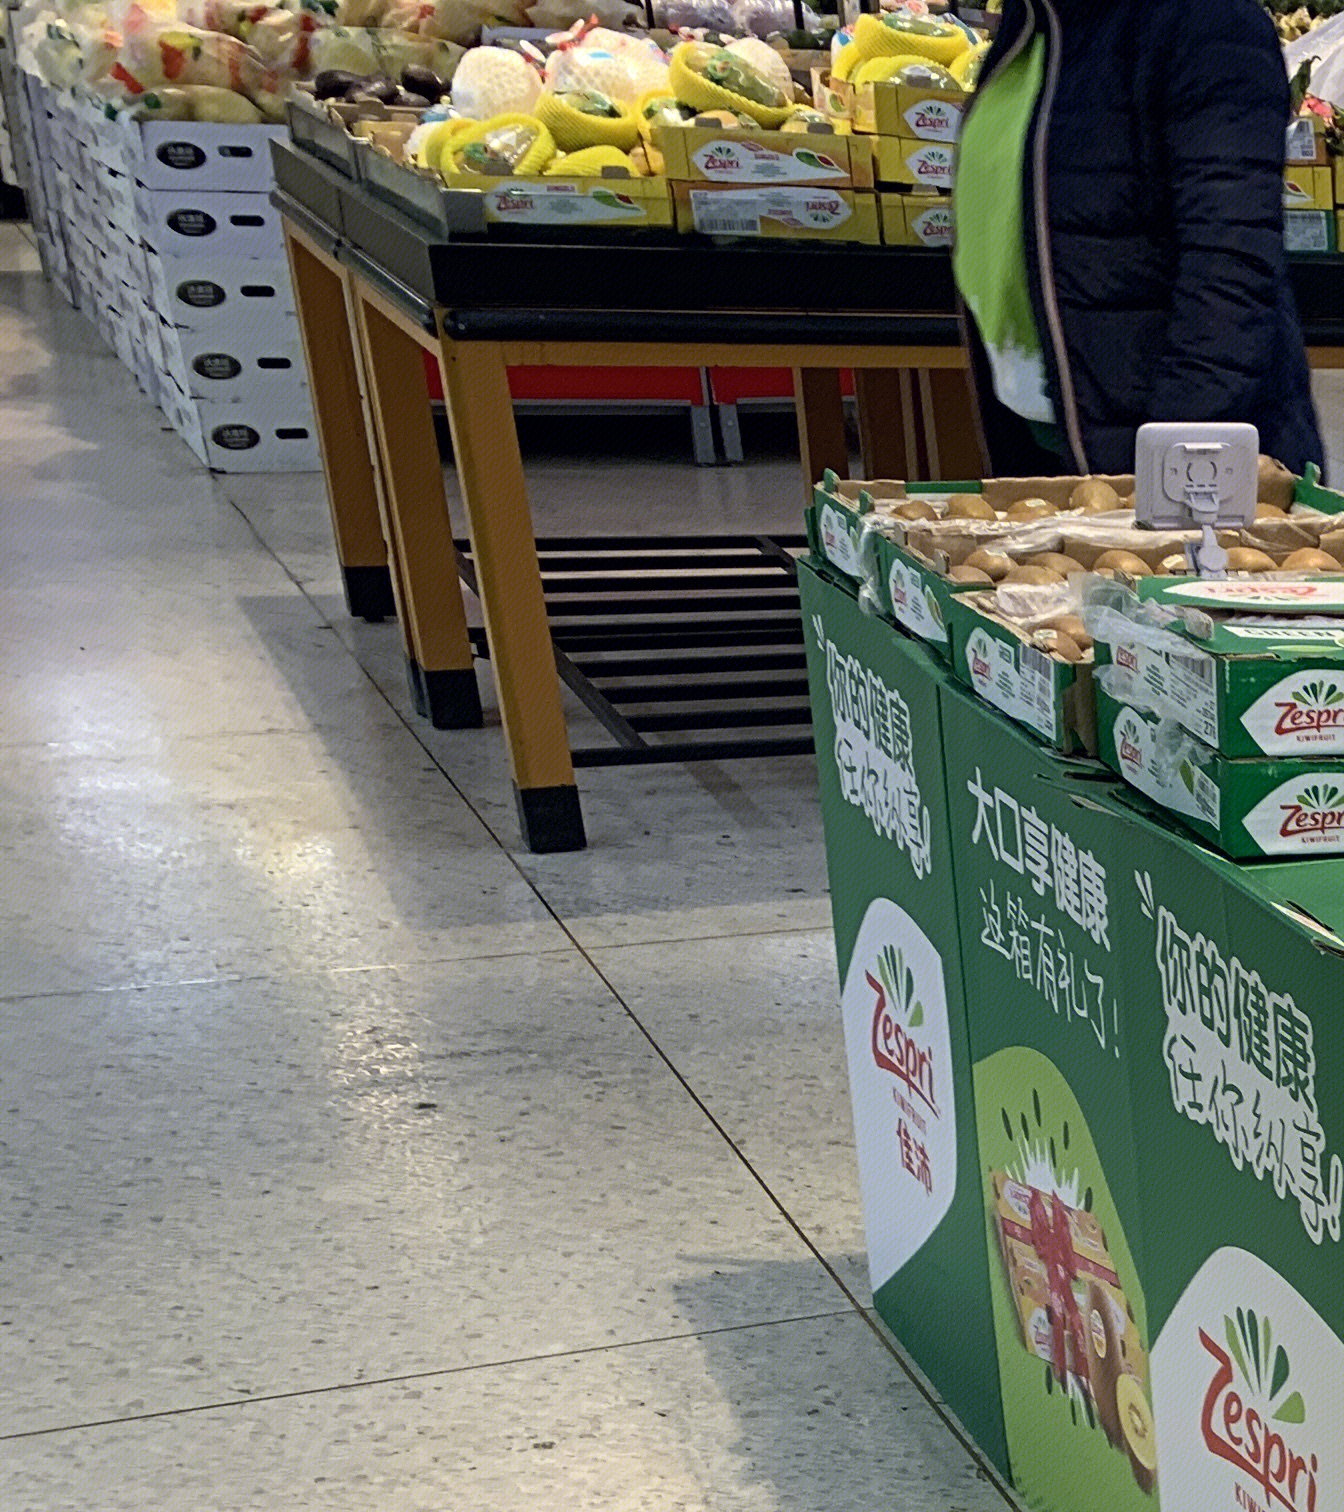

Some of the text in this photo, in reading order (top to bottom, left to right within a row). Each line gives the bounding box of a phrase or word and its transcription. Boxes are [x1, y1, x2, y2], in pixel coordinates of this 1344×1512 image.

[828, 645, 911, 769] 你的健康
[967, 767, 1109, 951] 大口享健康
[866, 969, 941, 1119] Zespri
[979, 880, 1120, 1058] 这箱有礼了!
[1160, 910, 1312, 1103] 你的健康
[896, 1123, 934, 1197] 佳沛
